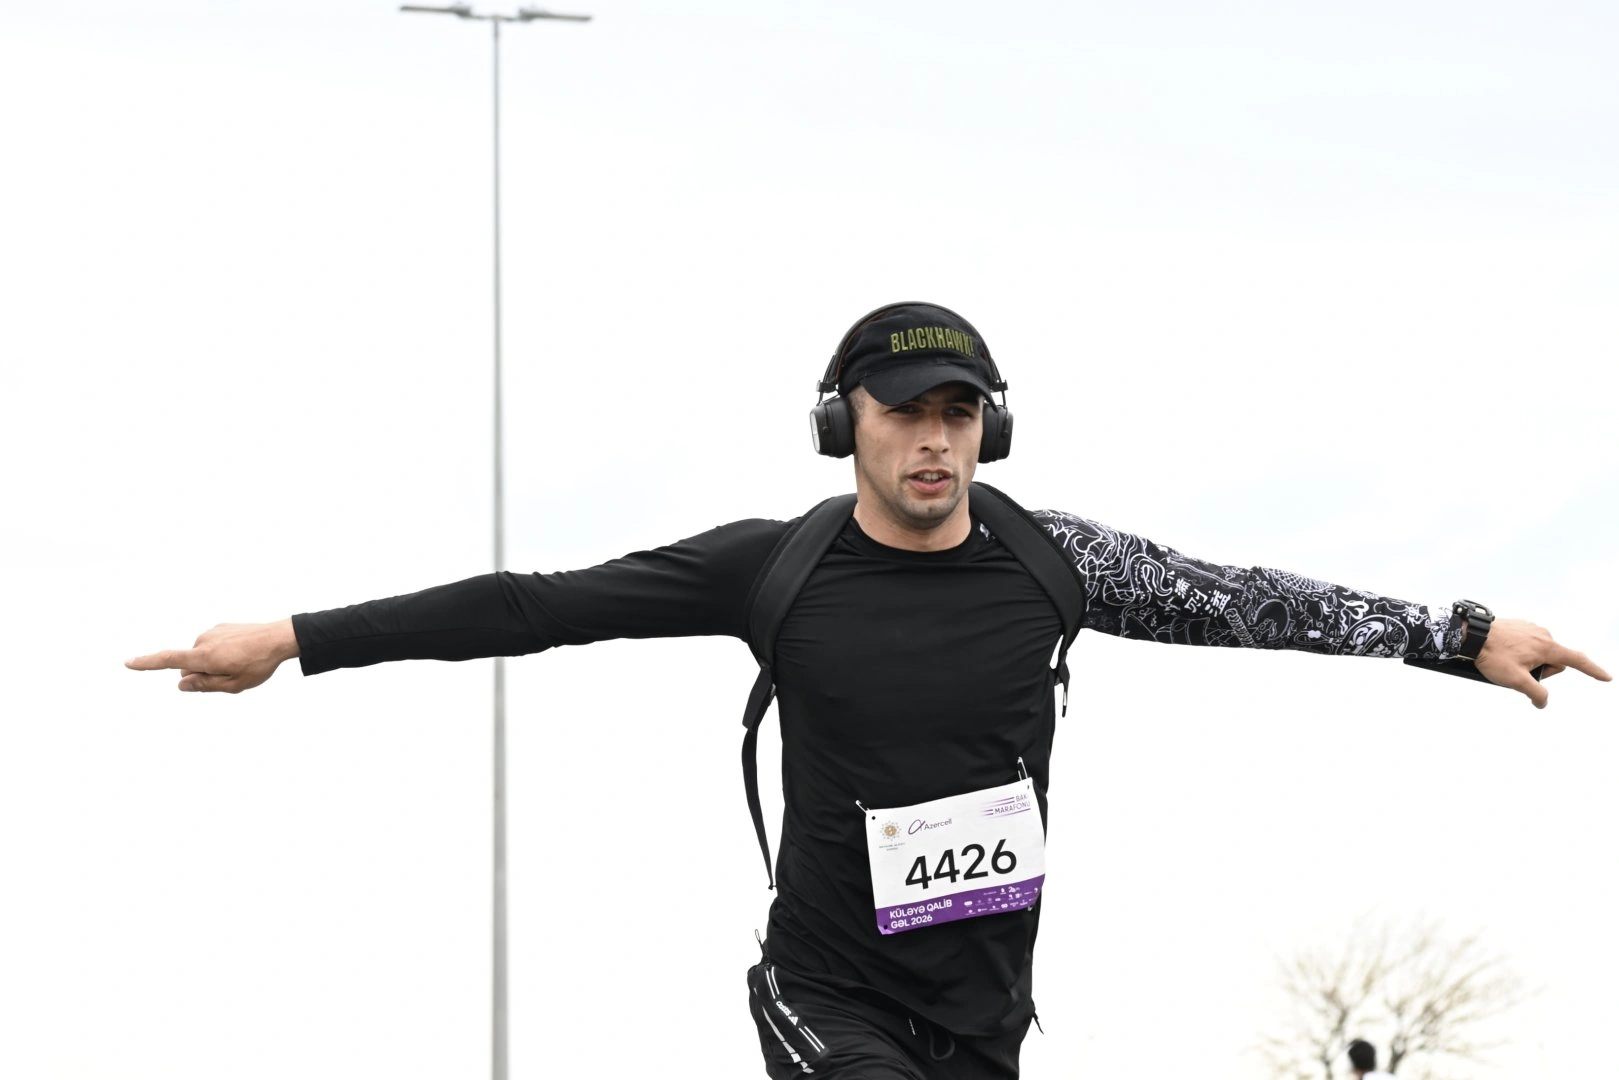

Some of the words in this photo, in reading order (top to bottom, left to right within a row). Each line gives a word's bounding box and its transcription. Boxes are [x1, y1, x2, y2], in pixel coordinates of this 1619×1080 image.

[890, 326, 975, 358] BLACKHAWK!
[995, 801, 1031, 814] MARAFONU
[924, 818, 953, 831] Azercell
[905, 839, 1017, 890] 4426
[889, 905, 926, 919] KÜLƏYƏ
[926, 898, 953, 912] QALİB
[890, 918, 910, 929] GƏL
[911, 914, 933, 926] 2026
